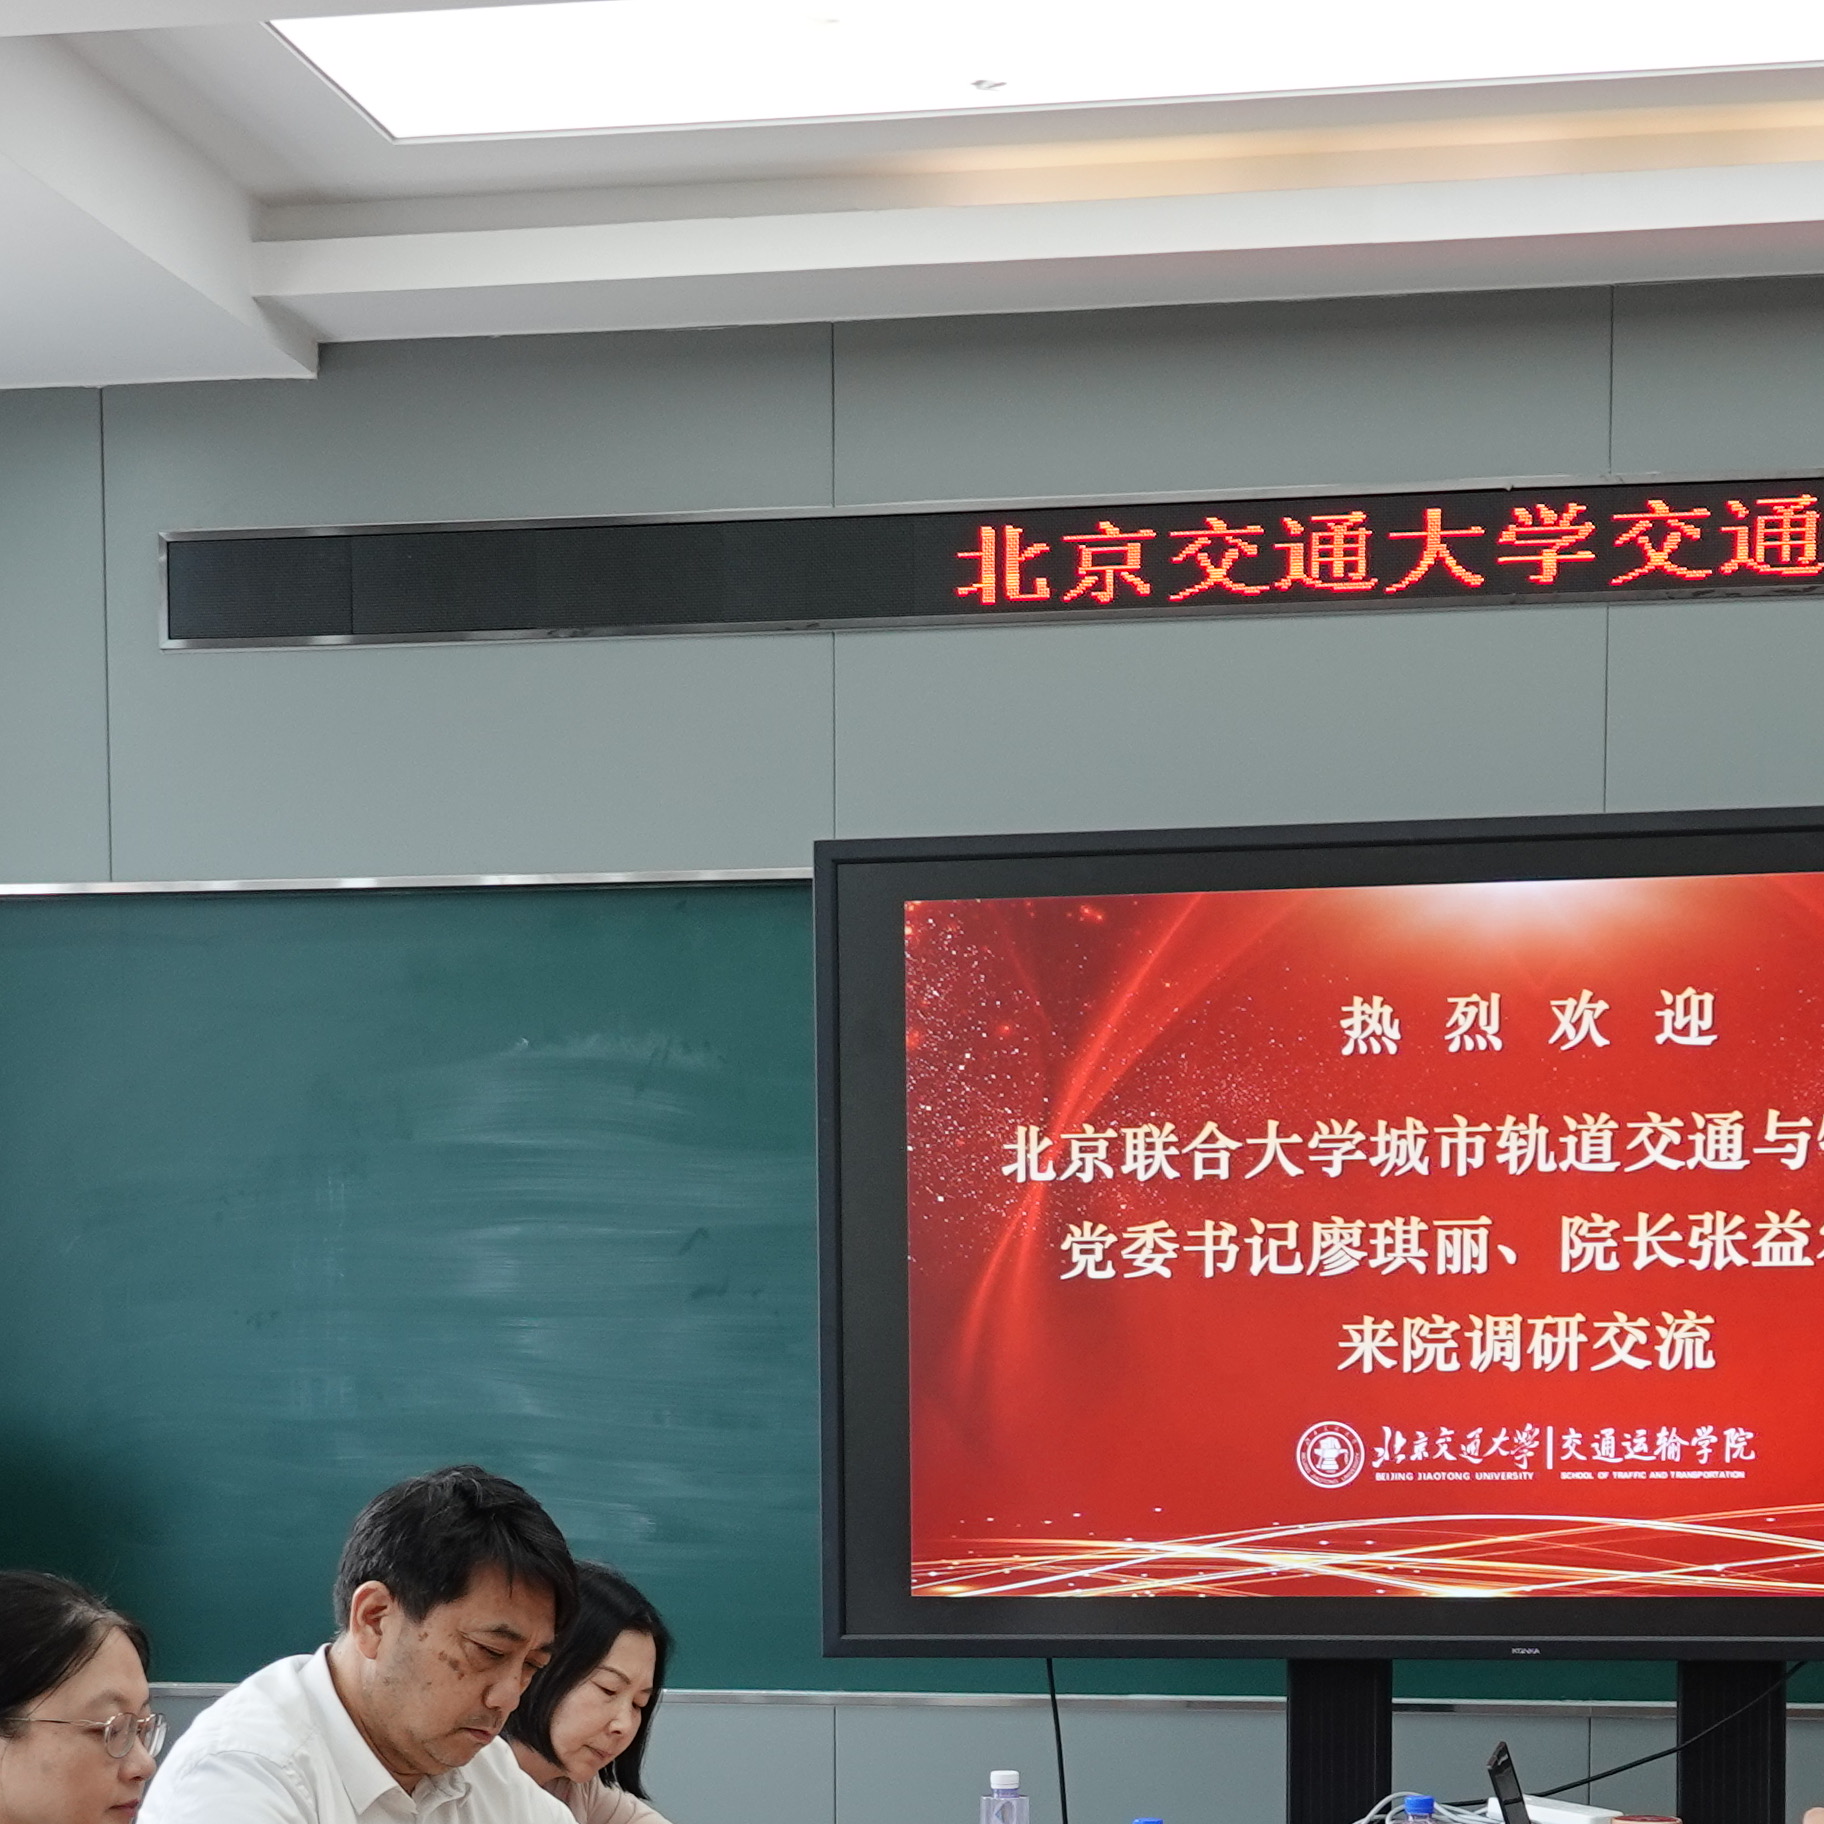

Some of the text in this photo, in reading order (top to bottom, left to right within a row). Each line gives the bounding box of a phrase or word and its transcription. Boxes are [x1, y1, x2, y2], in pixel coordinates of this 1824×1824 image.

[1340, 986, 1718, 1056] 热烈欢迎
[1337, 1310, 1716, 1374] 来院调研交流
[1560, 1426, 1756, 1465] 交通运输学院
[1375, 1471, 1535, 1482] BEIJING JIAOTONG UNIVERSITY
[1560, 1470, 1746, 1480] SCHOOL OF TRAFFIC AND TRANSPORTATION
